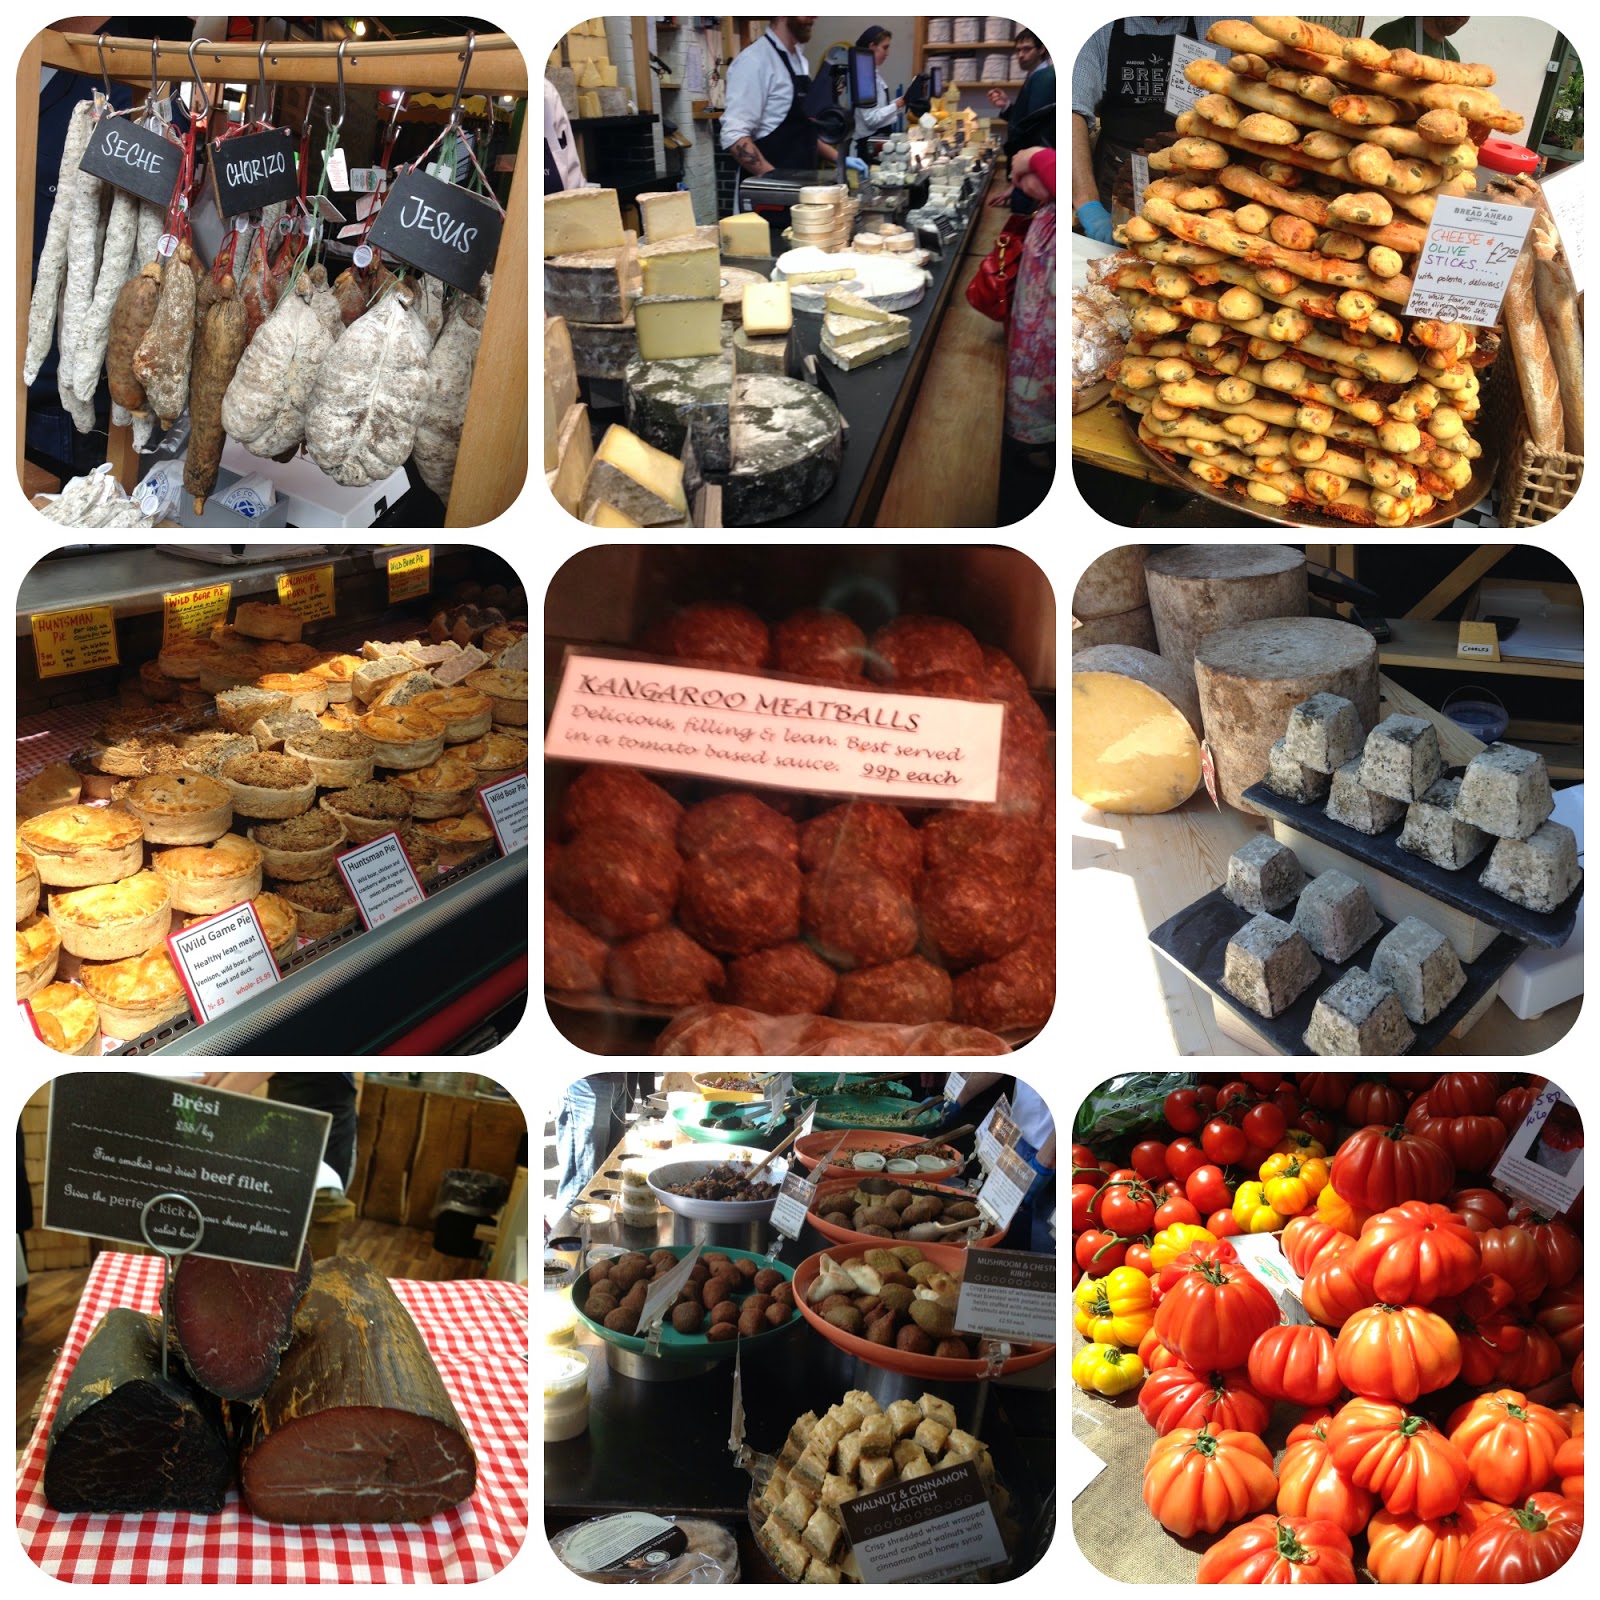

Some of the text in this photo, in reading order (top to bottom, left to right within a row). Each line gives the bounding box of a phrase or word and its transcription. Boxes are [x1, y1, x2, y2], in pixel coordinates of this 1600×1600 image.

[101, 131, 164, 174] SECHE
[226, 152, 285, 187] CHORIZO
[400, 195, 478, 253] JESUS
[1454, 207, 1482, 217] BREAD
[1484, 211, 1513, 221] AHEAD
[1428, 243, 1470, 256] OLIVE
[1431, 229, 1484, 245] CHEESE
[1418, 272, 1433, 280] with
[1469, 279, 1504, 290] delicious!
[38, 613, 93, 632] HUNTSMAN
[578, 673, 921, 731] KANGAROO MEATBALLS
[564, 727, 962, 785] in a tomato based sauce. 99p each
[682, 716, 754, 743] filling
[783, 728, 839, 747] lean.
[845, 735, 891, 754] Best
[894, 741, 965, 761] served
[490, 783, 526, 802] Wild Boar Pie
[347, 844, 396, 872] Huntsman Pie
[182, 915, 251, 954] Wild Game Pie
[194, 935, 256, 971] Healthy lean meat
[196, 971, 221, 987] Venison,
[221, 965, 233, 974] wild
[215, 979, 229, 989] fowl
[230, 974, 240, 982] and
[216, 997, 225, 1006] £3
[256, 971, 271, 985] £5.95
[172, 1092, 220, 1117] Brési
[92, 1146, 274, 1194] Fine smoked and dried beef filet.
[63, 1184, 89, 1200] Gives
[92, 1185, 107, 1202] the
[159, 1202, 186, 1218] kick
[188, 1209, 197, 1220] to
[222, 1215, 248, 1230] cheese
[249, 1217, 278, 1235] platter
[153, 1222, 178, 1237] salad
[977, 1258, 1021, 1269] MUSHROOM
[1010, 1270, 1032, 1278] KIBEH
[852, 1468, 969, 1514] WALNUT & CINNAMON
[890, 1491, 937, 1513] KATEYEH
[864, 1508, 985, 1553] Crisp shredded wheat wrapped
[869, 1522, 983, 1563] around crushed walnuts with
[876, 1533, 983, 1572] cinnamon and honey syrup
